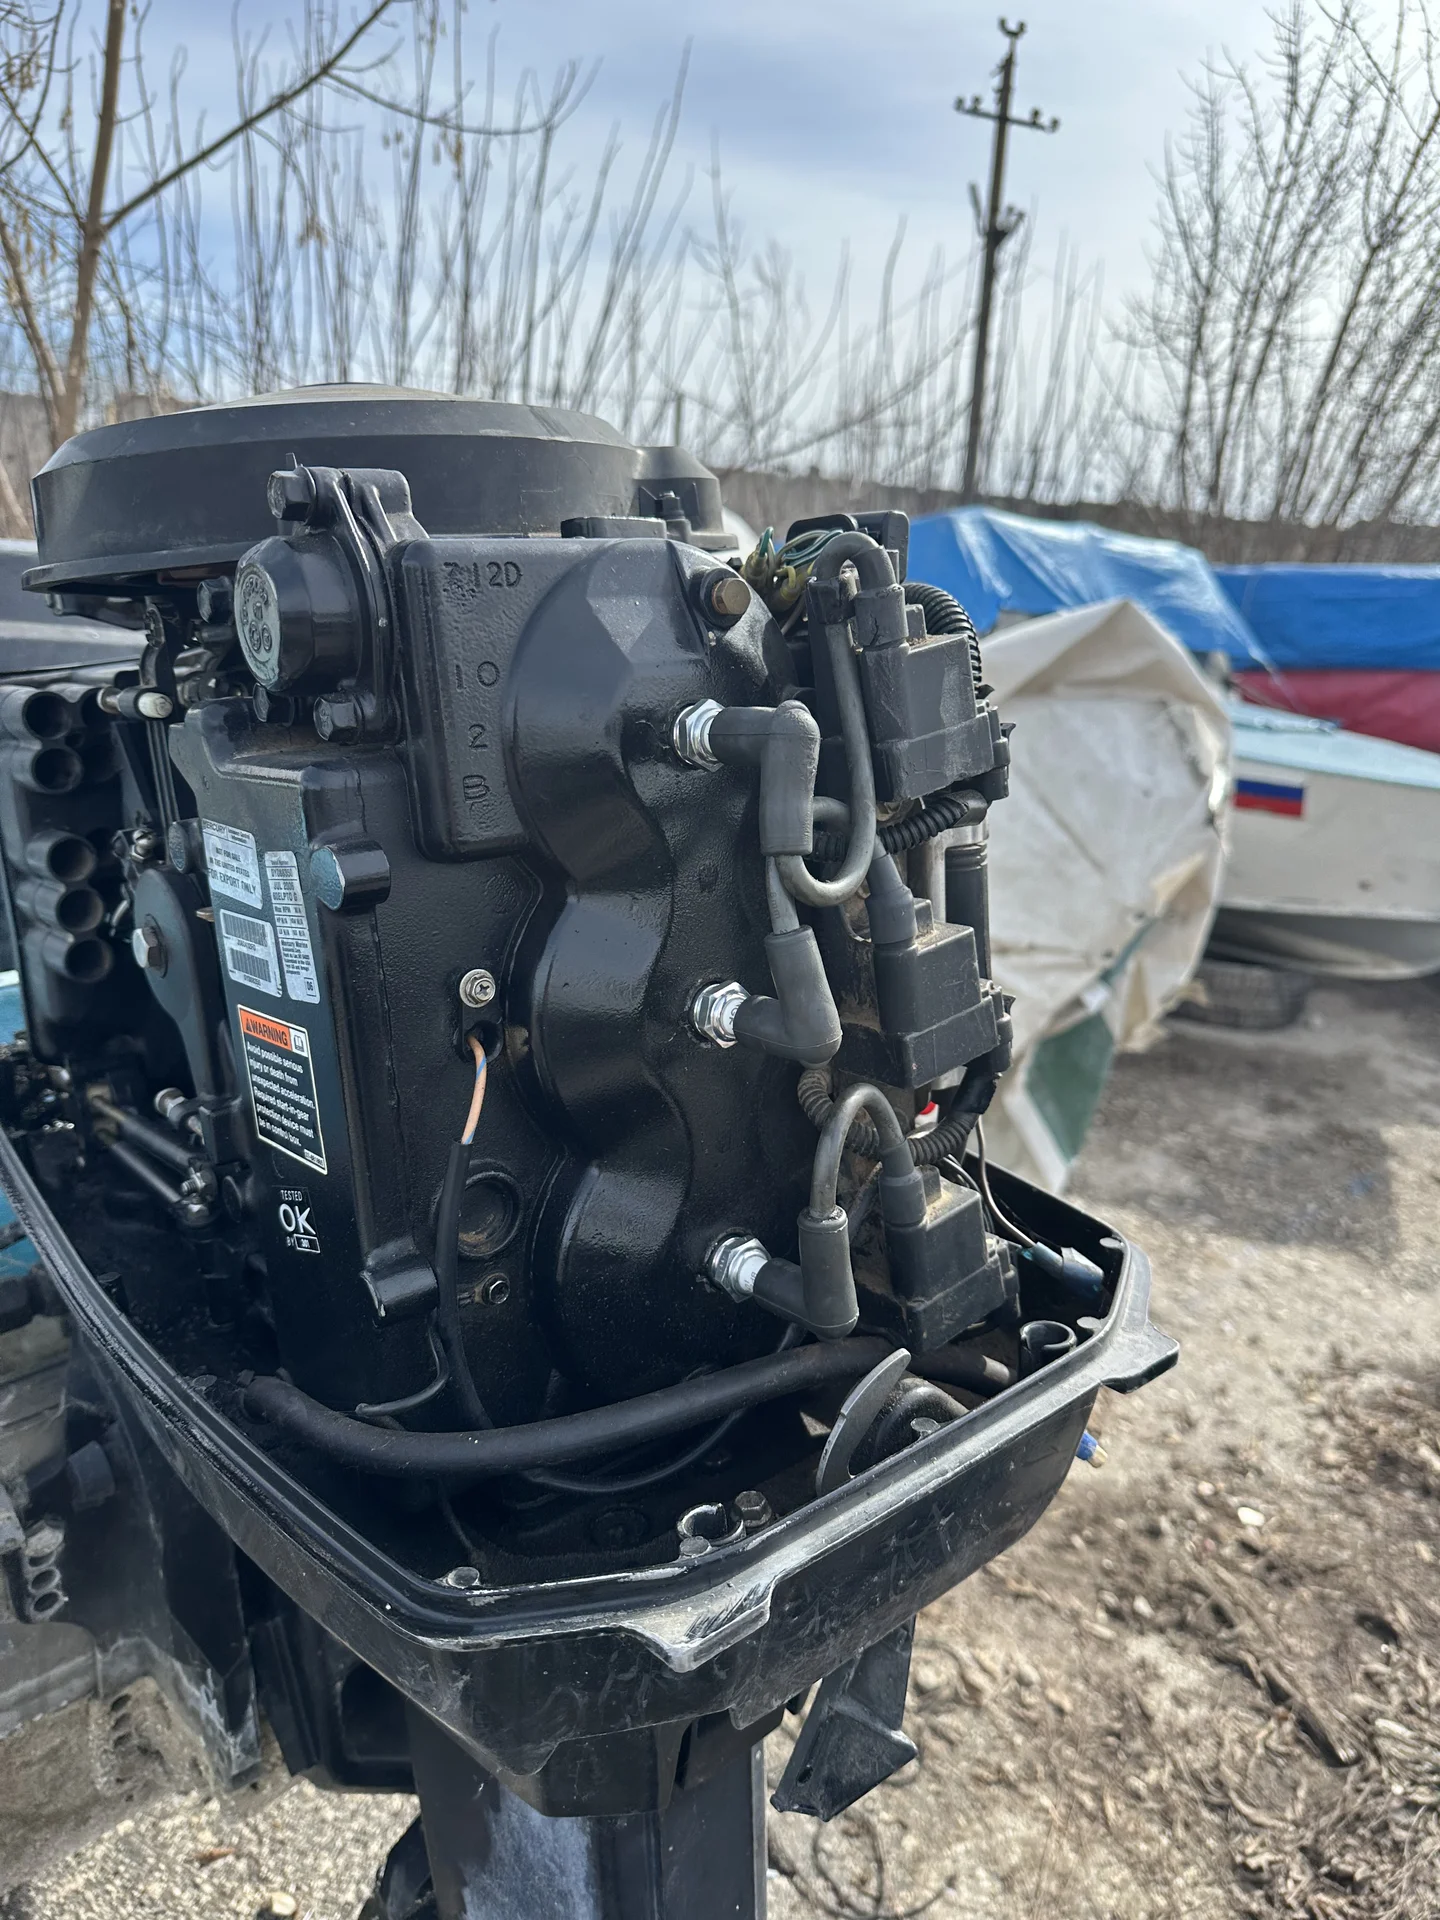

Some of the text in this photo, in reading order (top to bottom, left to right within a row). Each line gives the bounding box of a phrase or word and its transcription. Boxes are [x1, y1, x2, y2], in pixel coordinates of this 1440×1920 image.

[468, 724, 489, 749] 2
[462, 774, 491, 801] B
[208, 868, 256, 894] FOR EXPORT ONLY
[273, 881, 282, 890] JUL
[250, 1019, 288, 1046] WARNING
[247, 1041, 303, 1074] Avoid possible serious
[248, 1056, 263, 1073] injury
[269, 1066, 285, 1080] death
[284, 1072, 299, 1086] from
[252, 1073, 315, 1109] unexpected acceleration.
[254, 1086, 309, 1121] Required start-in-gear
[256, 1103, 314, 1138] protection device must
[258, 1116, 266, 1127] be
[271, 1124, 289, 1139] control
[288, 1132, 301, 1146] box.
[280, 1190, 303, 1201] TESTED
[279, 1203, 317, 1235] OK
[286, 1236, 295, 1246] BY
